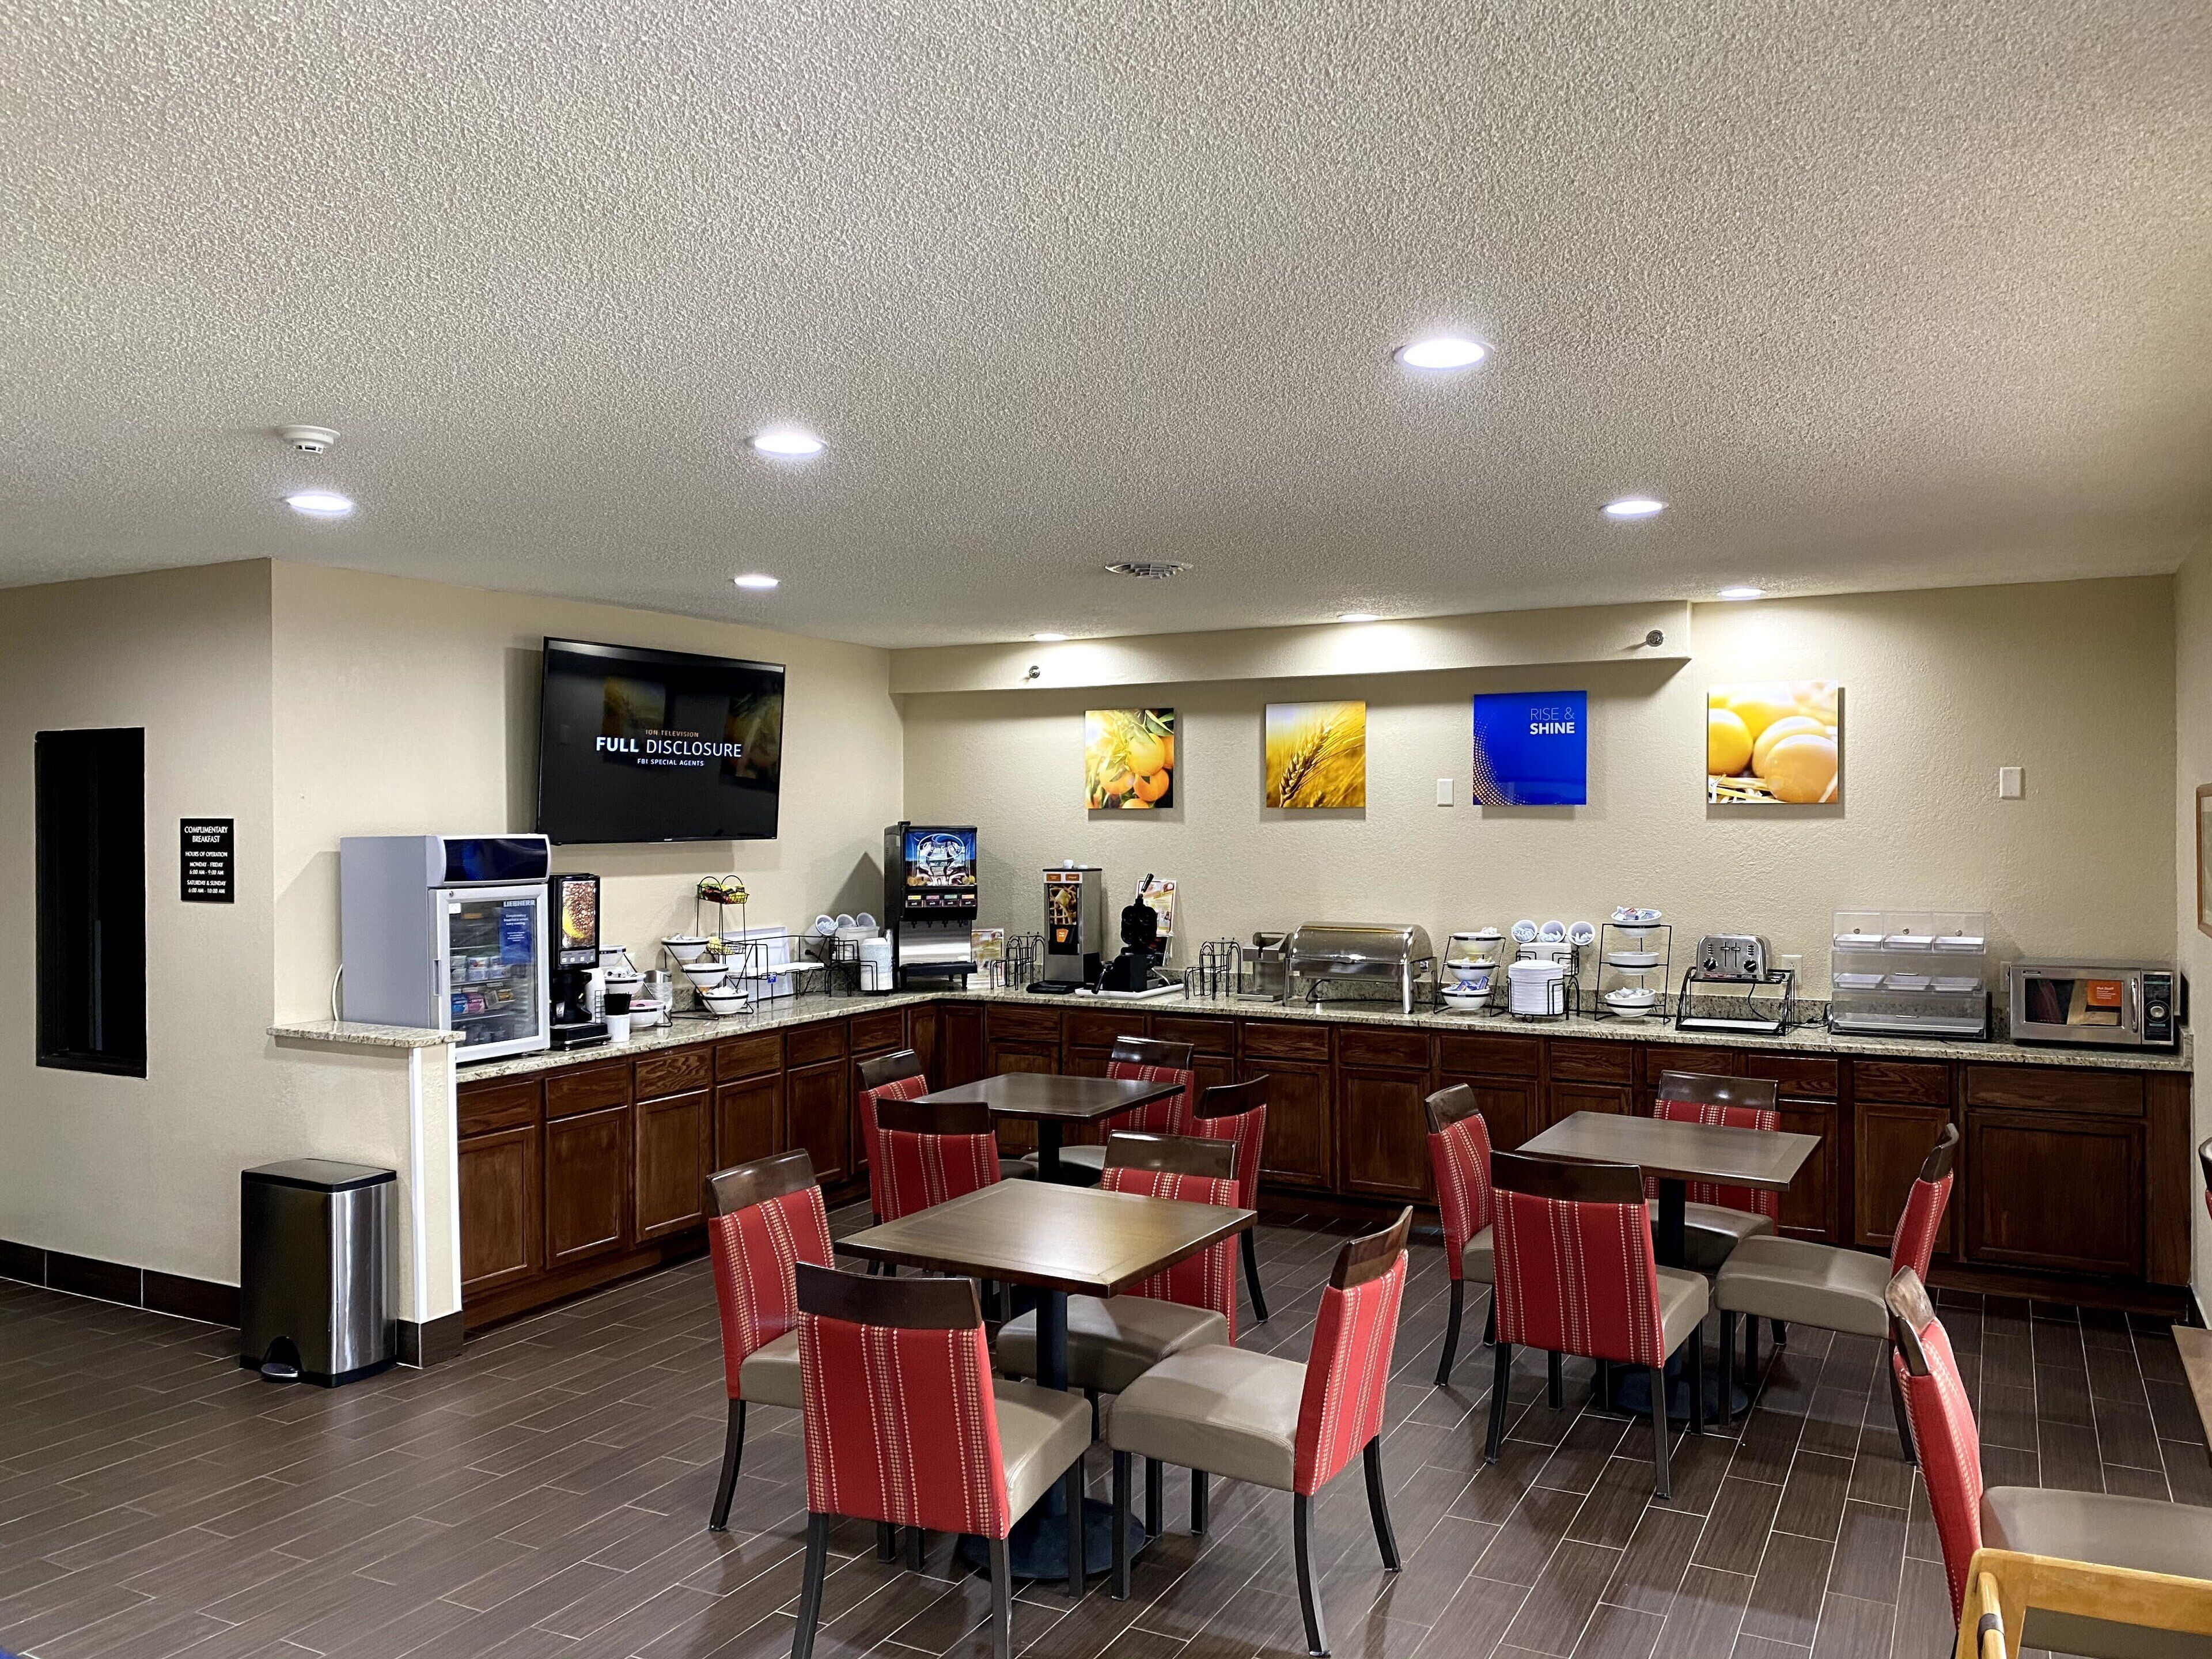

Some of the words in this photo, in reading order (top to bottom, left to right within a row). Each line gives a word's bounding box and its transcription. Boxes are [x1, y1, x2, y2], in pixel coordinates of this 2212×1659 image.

[1531, 707, 1559, 721] RISE
[1564, 707, 1575, 720] &
[661, 730, 699, 738] TELEVISION
[1529, 722, 1575, 735] SHINE
[596, 736, 639, 753] FULL
[646, 739, 742, 757] DISCLOSURE
